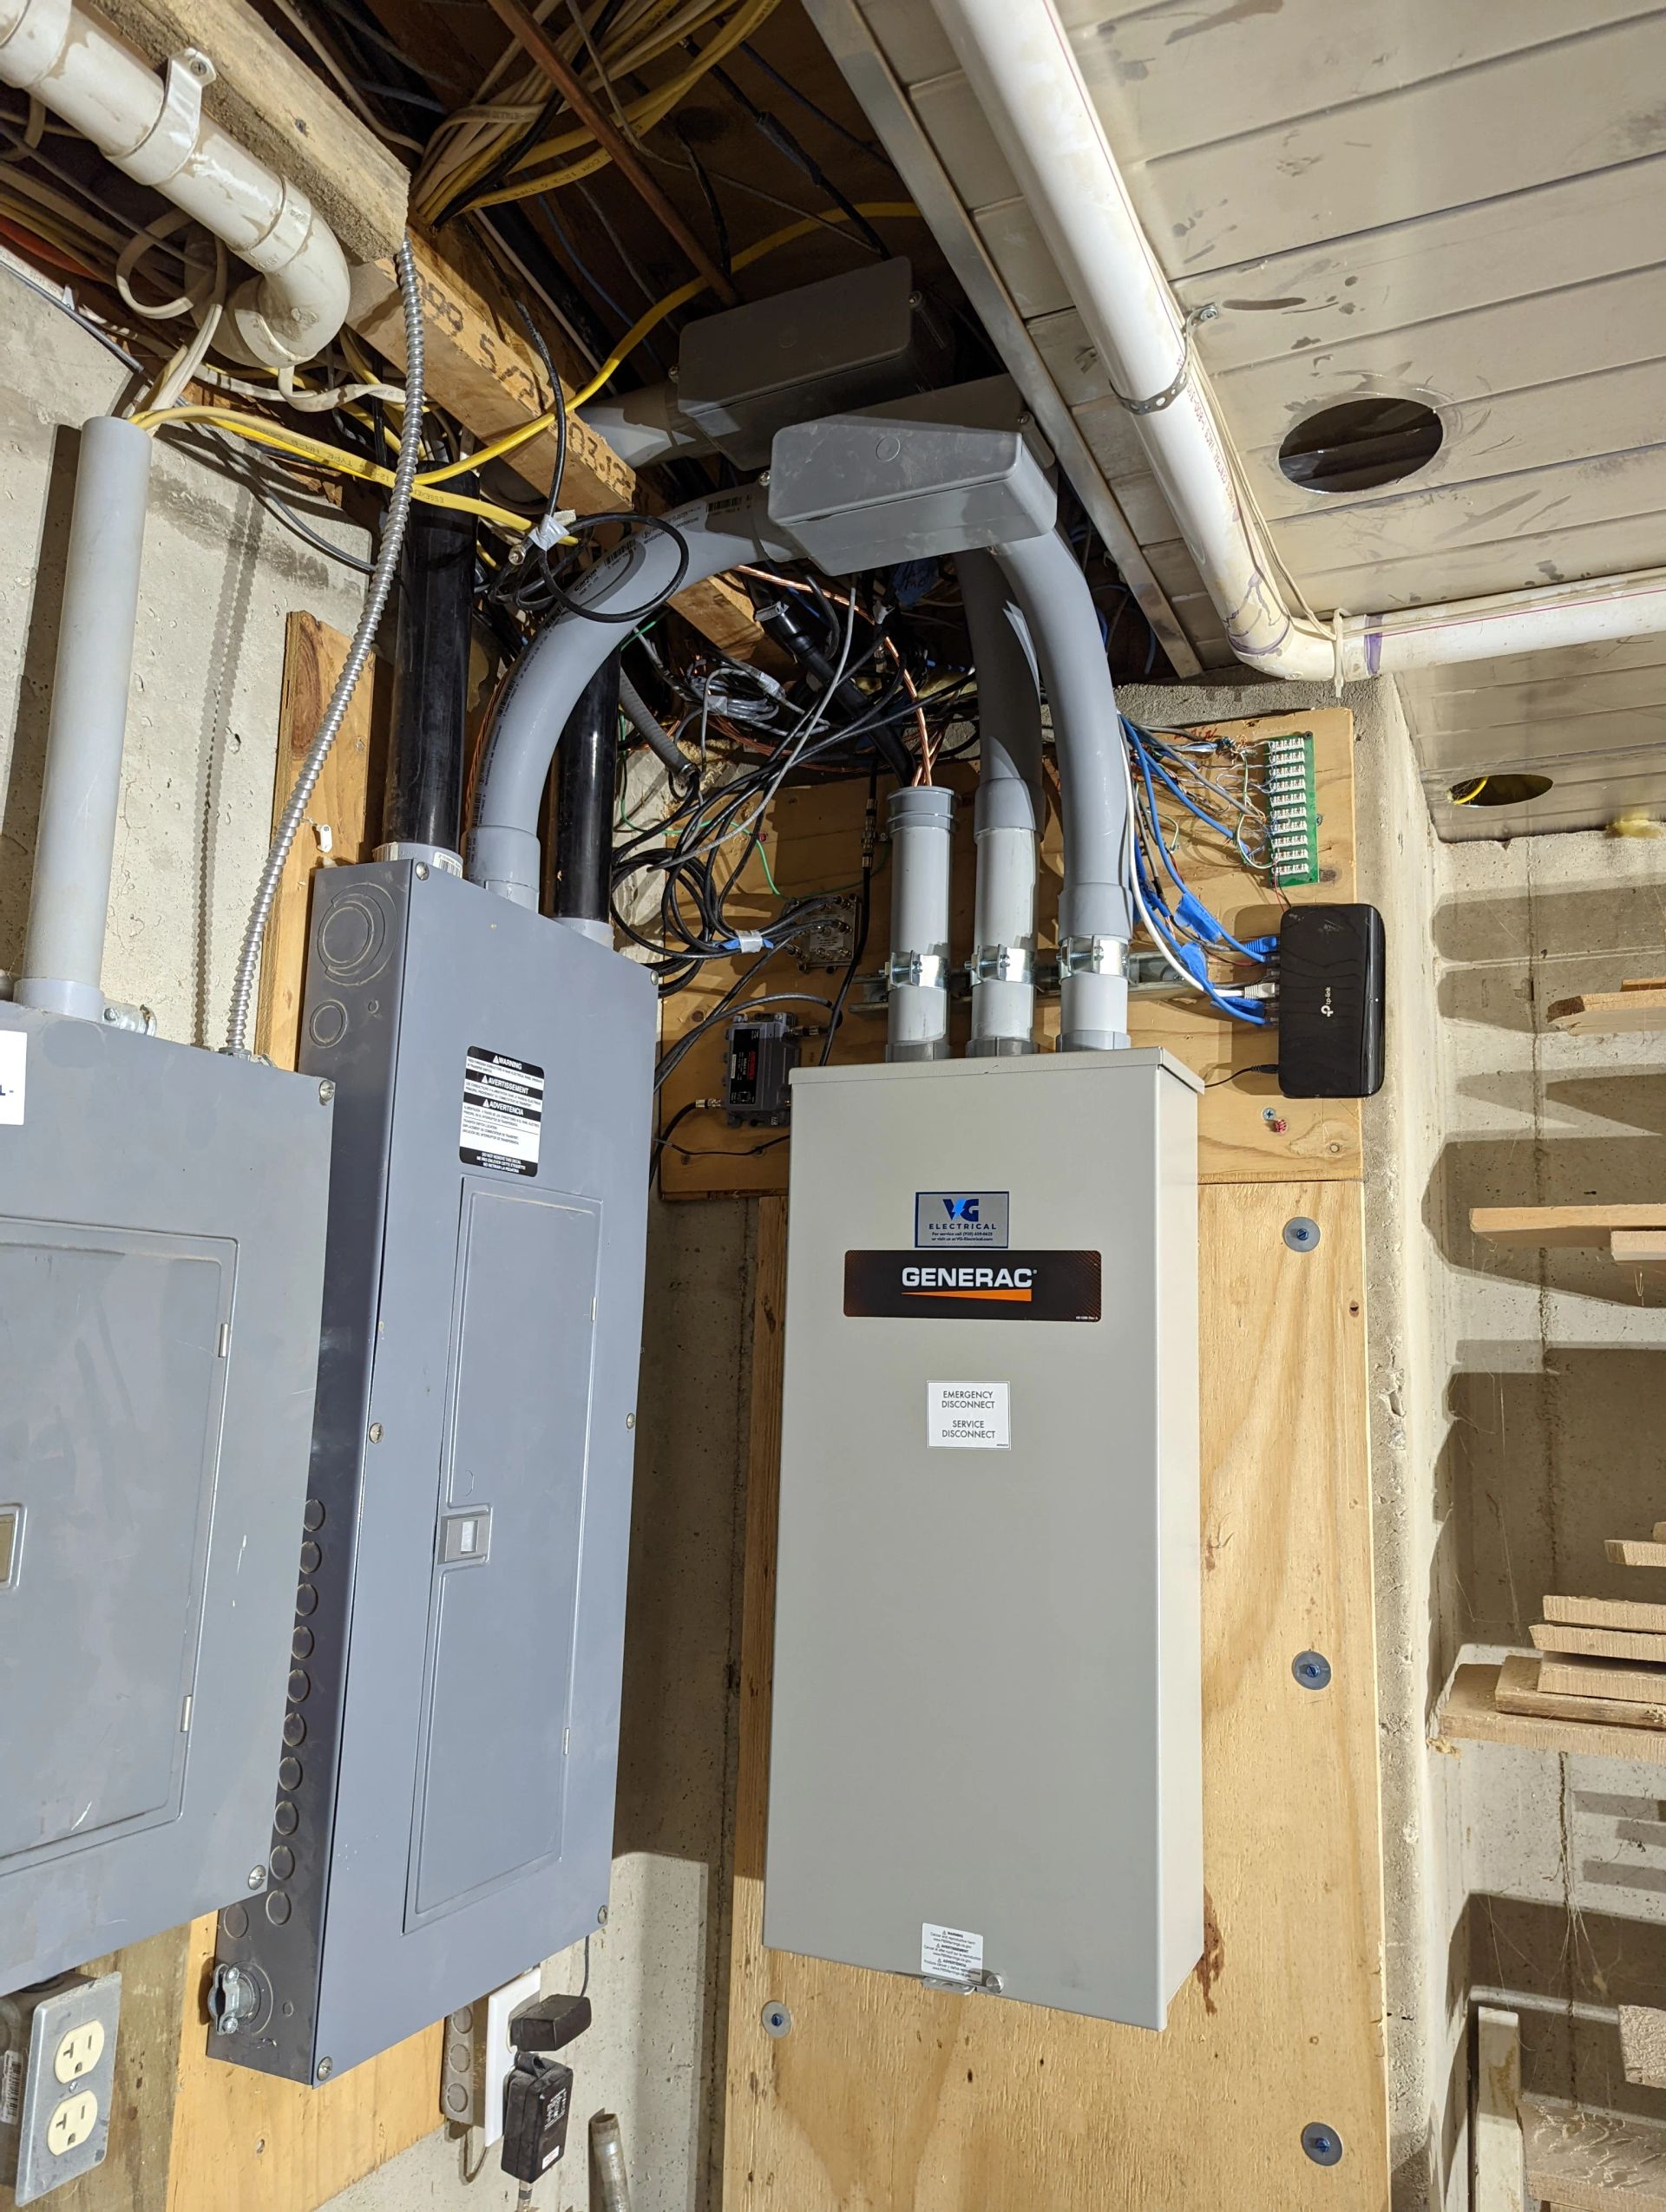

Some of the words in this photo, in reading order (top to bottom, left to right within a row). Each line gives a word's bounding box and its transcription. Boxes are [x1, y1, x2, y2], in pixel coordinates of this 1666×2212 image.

[498, 1056, 522, 1070] WARNING
[488, 1076, 529, 1095] AVERTISSEMENT
[489, 1100, 524, 1116] ADVERTENCIA
[942, 1198, 979, 1222] VG
[902, 1267, 1033, 1287] GENERAC
[943, 1391, 994, 1399] EMERGENCY
[941, 1400, 995, 1409] DISCONNECT
[952, 1420, 985, 1429] SERVICE
[942, 1430, 995, 1438] DISCONNECT
